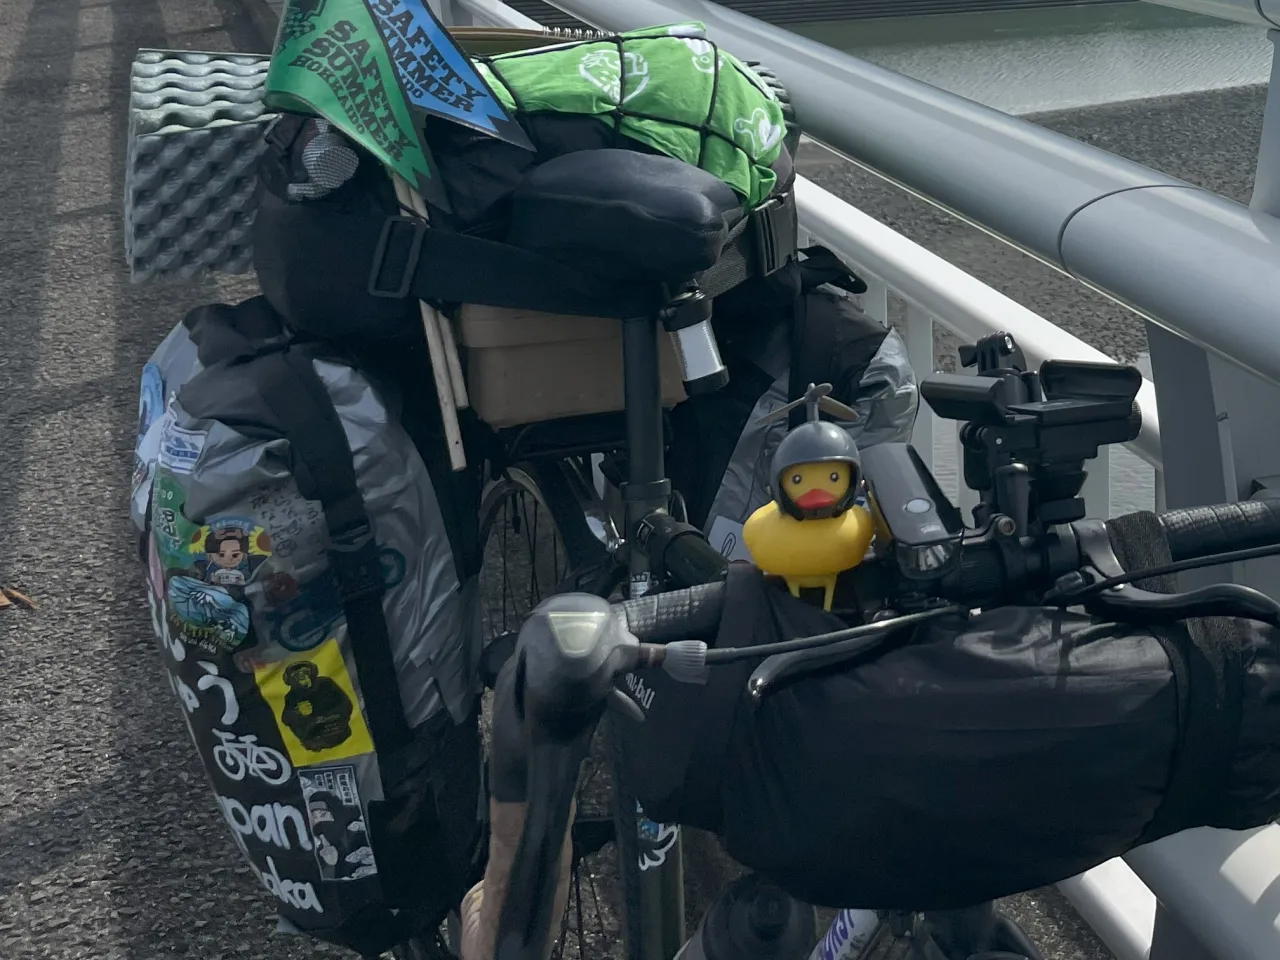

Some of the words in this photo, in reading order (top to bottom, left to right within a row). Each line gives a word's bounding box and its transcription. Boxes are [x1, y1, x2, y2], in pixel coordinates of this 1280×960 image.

[287, 55, 366, 135] HOKKAIDO
[302, 37, 404, 162] SUMMER
[324, 20, 418, 149] SAFETY
[377, 17, 475, 113] UMMER
